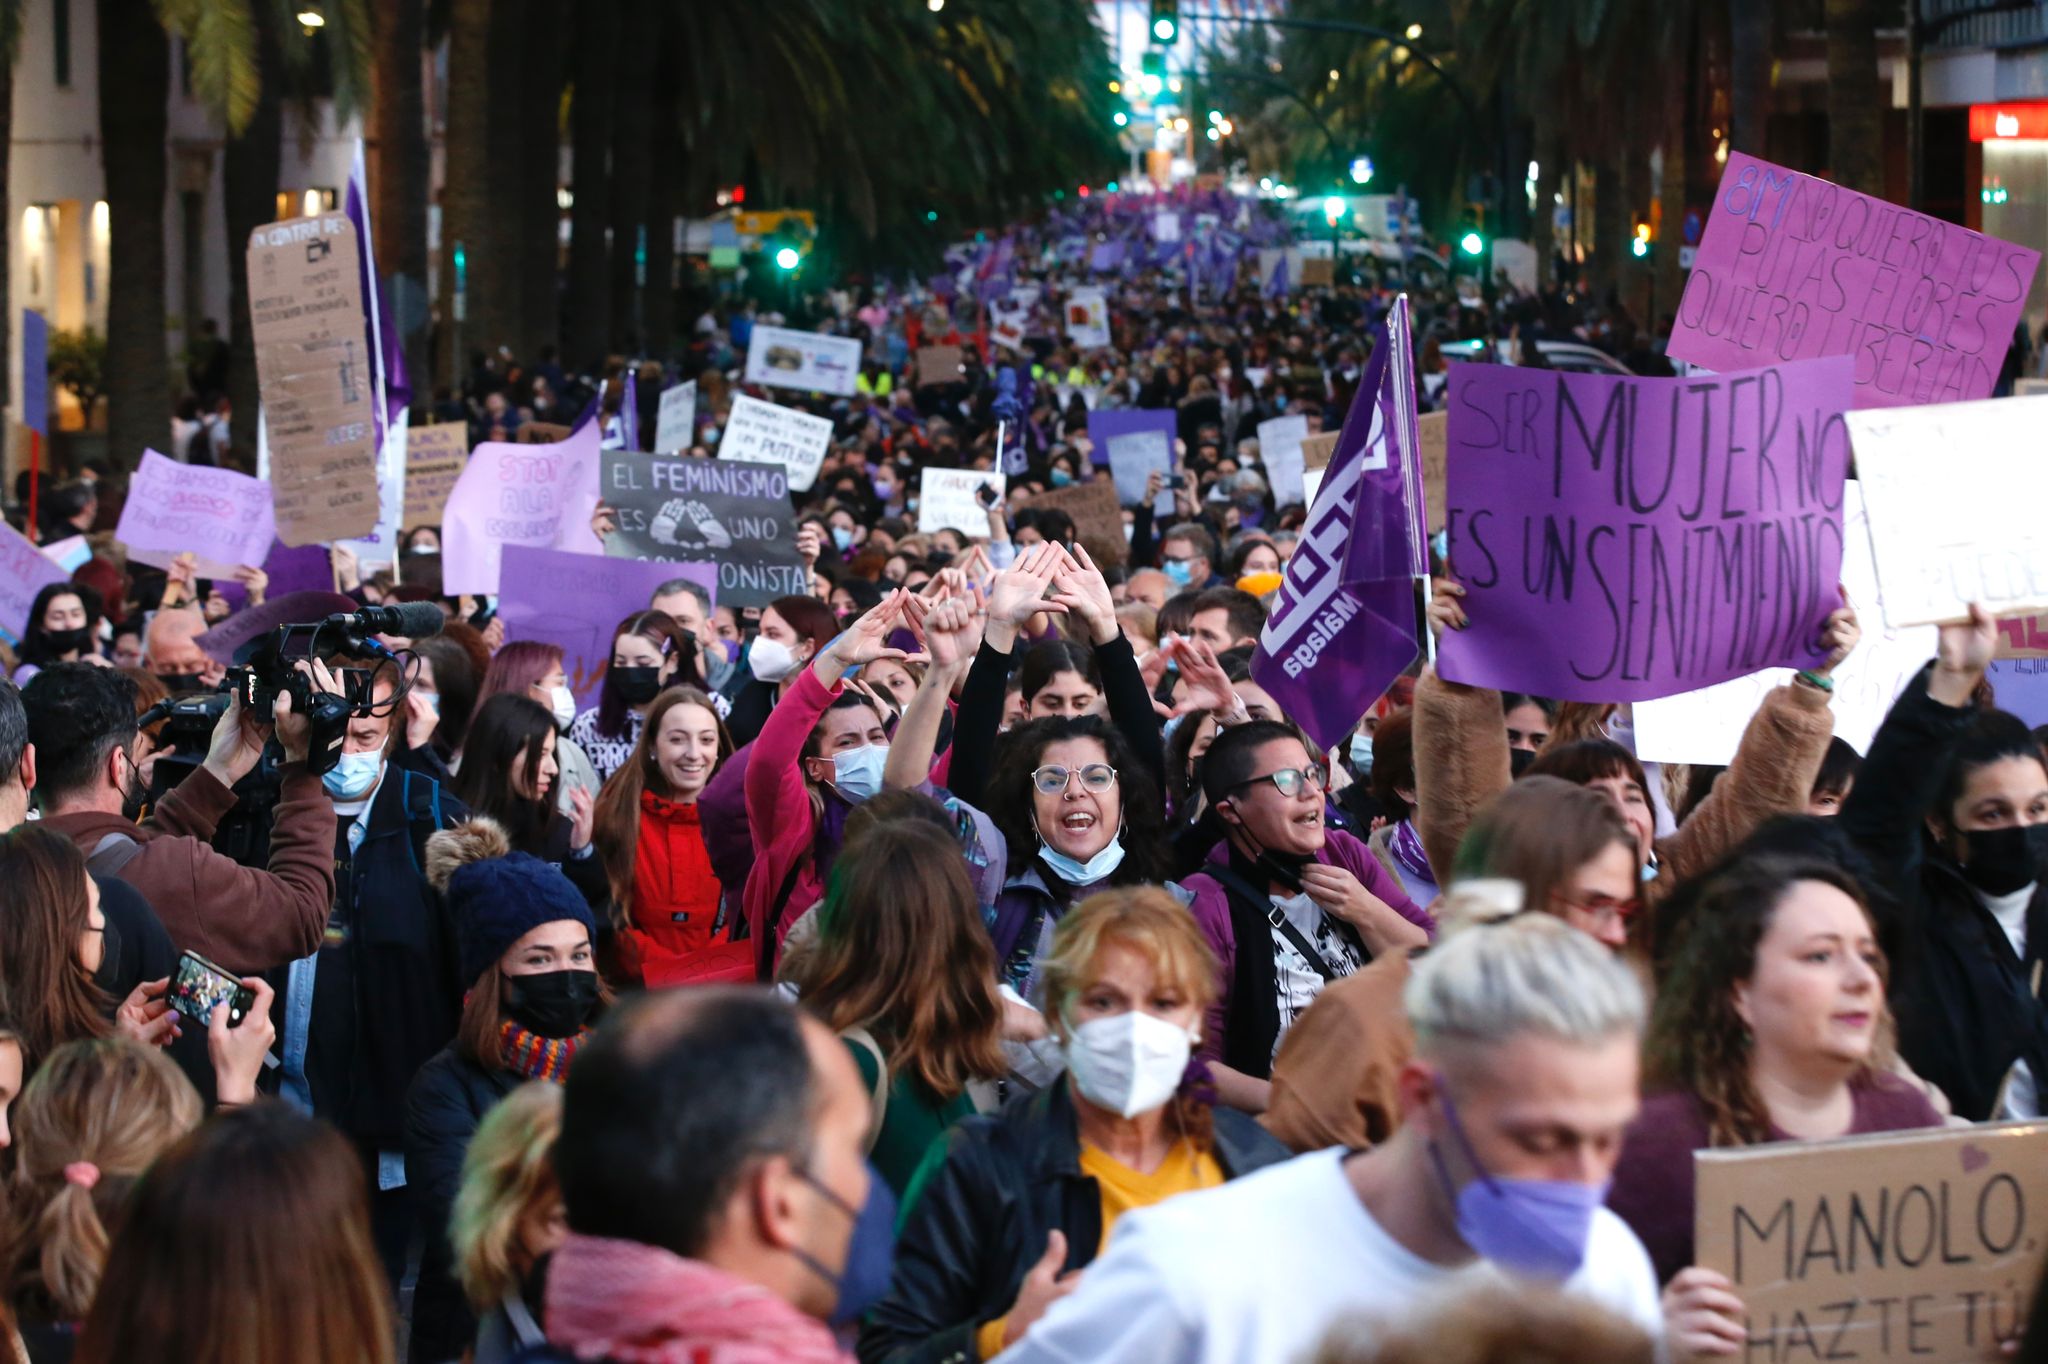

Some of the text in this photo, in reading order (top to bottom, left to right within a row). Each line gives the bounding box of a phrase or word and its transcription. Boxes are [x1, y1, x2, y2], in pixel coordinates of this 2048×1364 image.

[1723, 165, 2028, 303] 8M NO QUIERO TUS
[1731, 222, 1996, 356] PUTAS FLORES
[1680, 269, 1995, 402] QUIERO LIBERTAD
[612, 463, 642, 490] EL
[1459, 379, 1542, 460] SER
[1553, 368, 1784, 522] MUJER
[1796, 408, 1847, 512] NO
[617, 508, 778, 540] ES UNO
[1446, 508, 1499, 589] ES
[1523, 515, 1576, 603] UN
[1568, 512, 1843, 682] SENTIMIENTO
[1744, 1293, 1935, 1364] HAZTE
